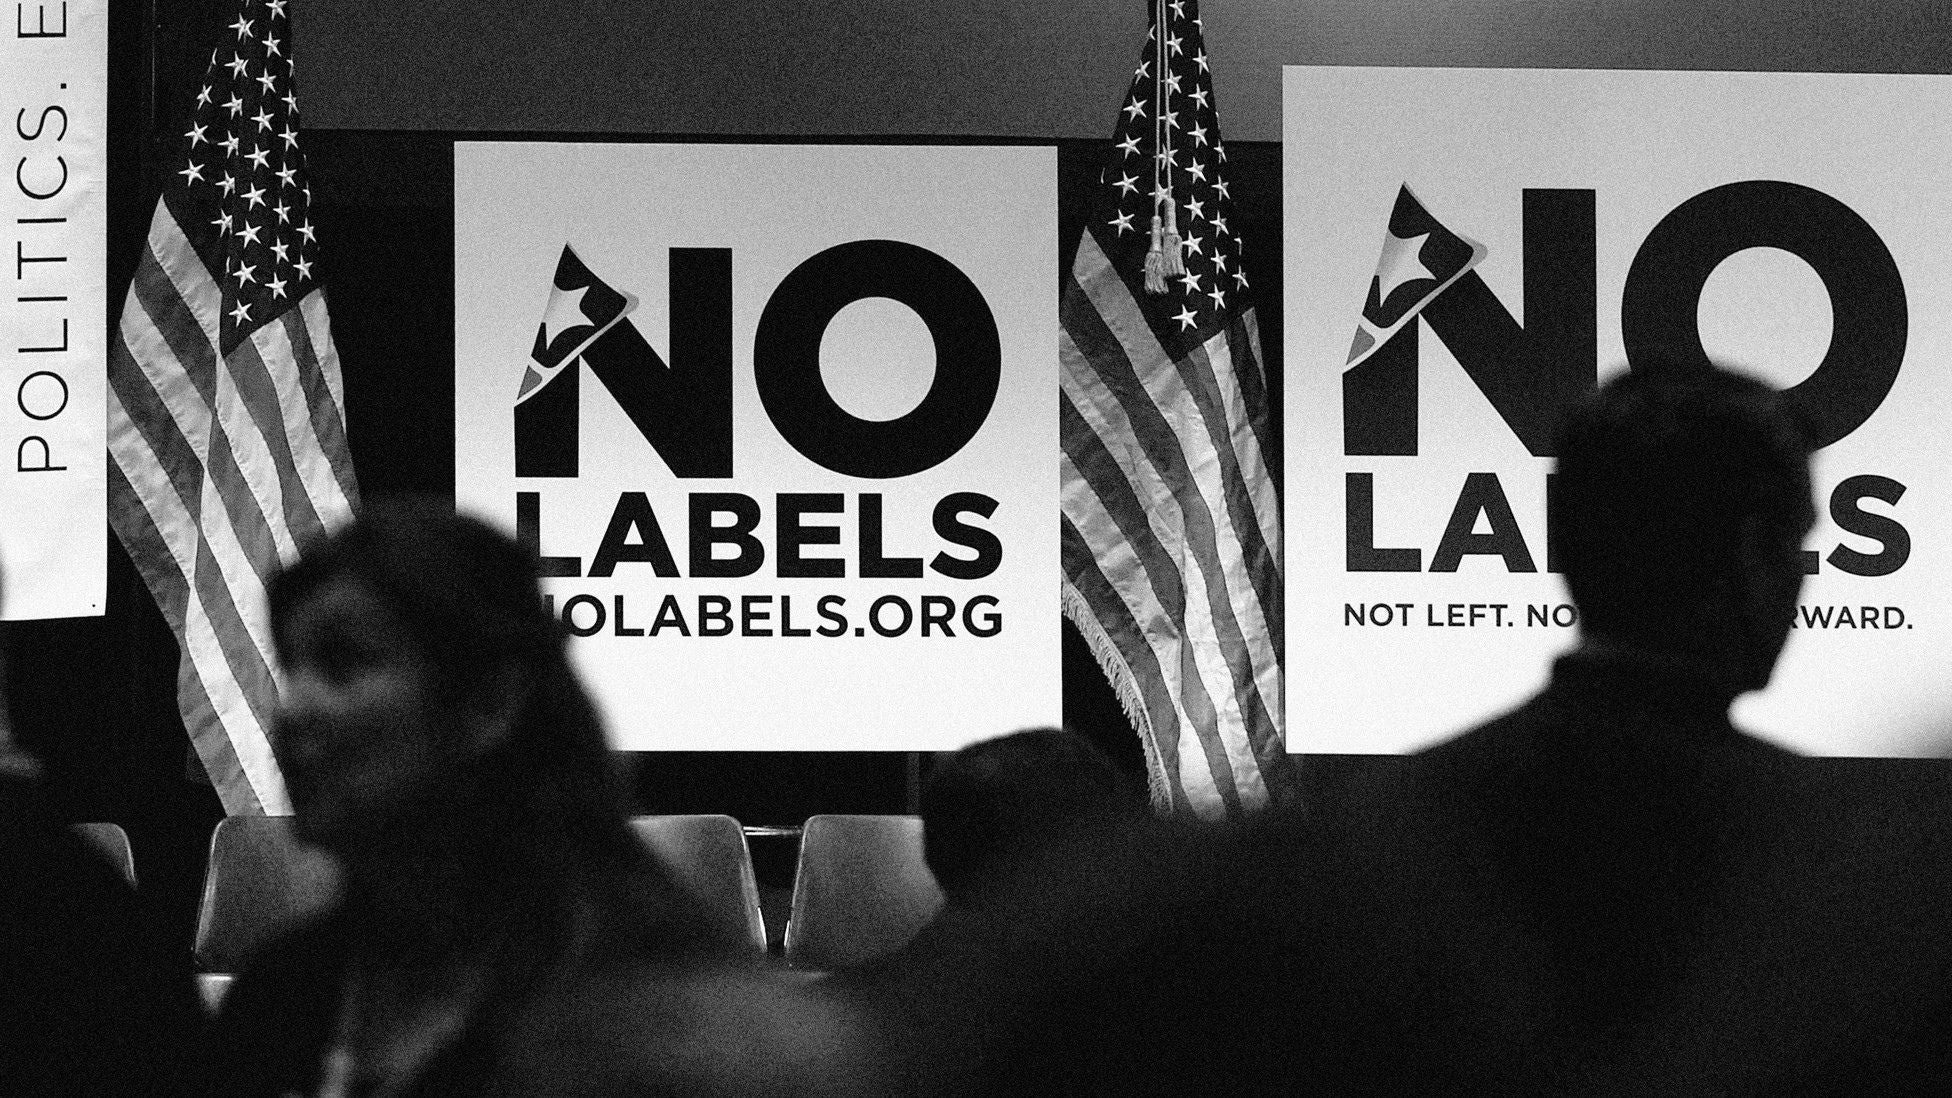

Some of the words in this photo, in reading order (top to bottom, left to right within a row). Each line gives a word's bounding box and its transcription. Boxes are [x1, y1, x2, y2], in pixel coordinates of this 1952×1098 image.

[16, 82, 69, 473] POLITICS.
[514, 239, 1002, 479] NO
[1342, 179, 1909, 457] NO
[516, 491, 1003, 579] LABELS
[1345, 472, 1911, 577] LAS
[1344, 603, 1414, 627] NOT
[1427, 603, 1513, 627] LEFT.
[1527, 604, 1579, 628] NO
